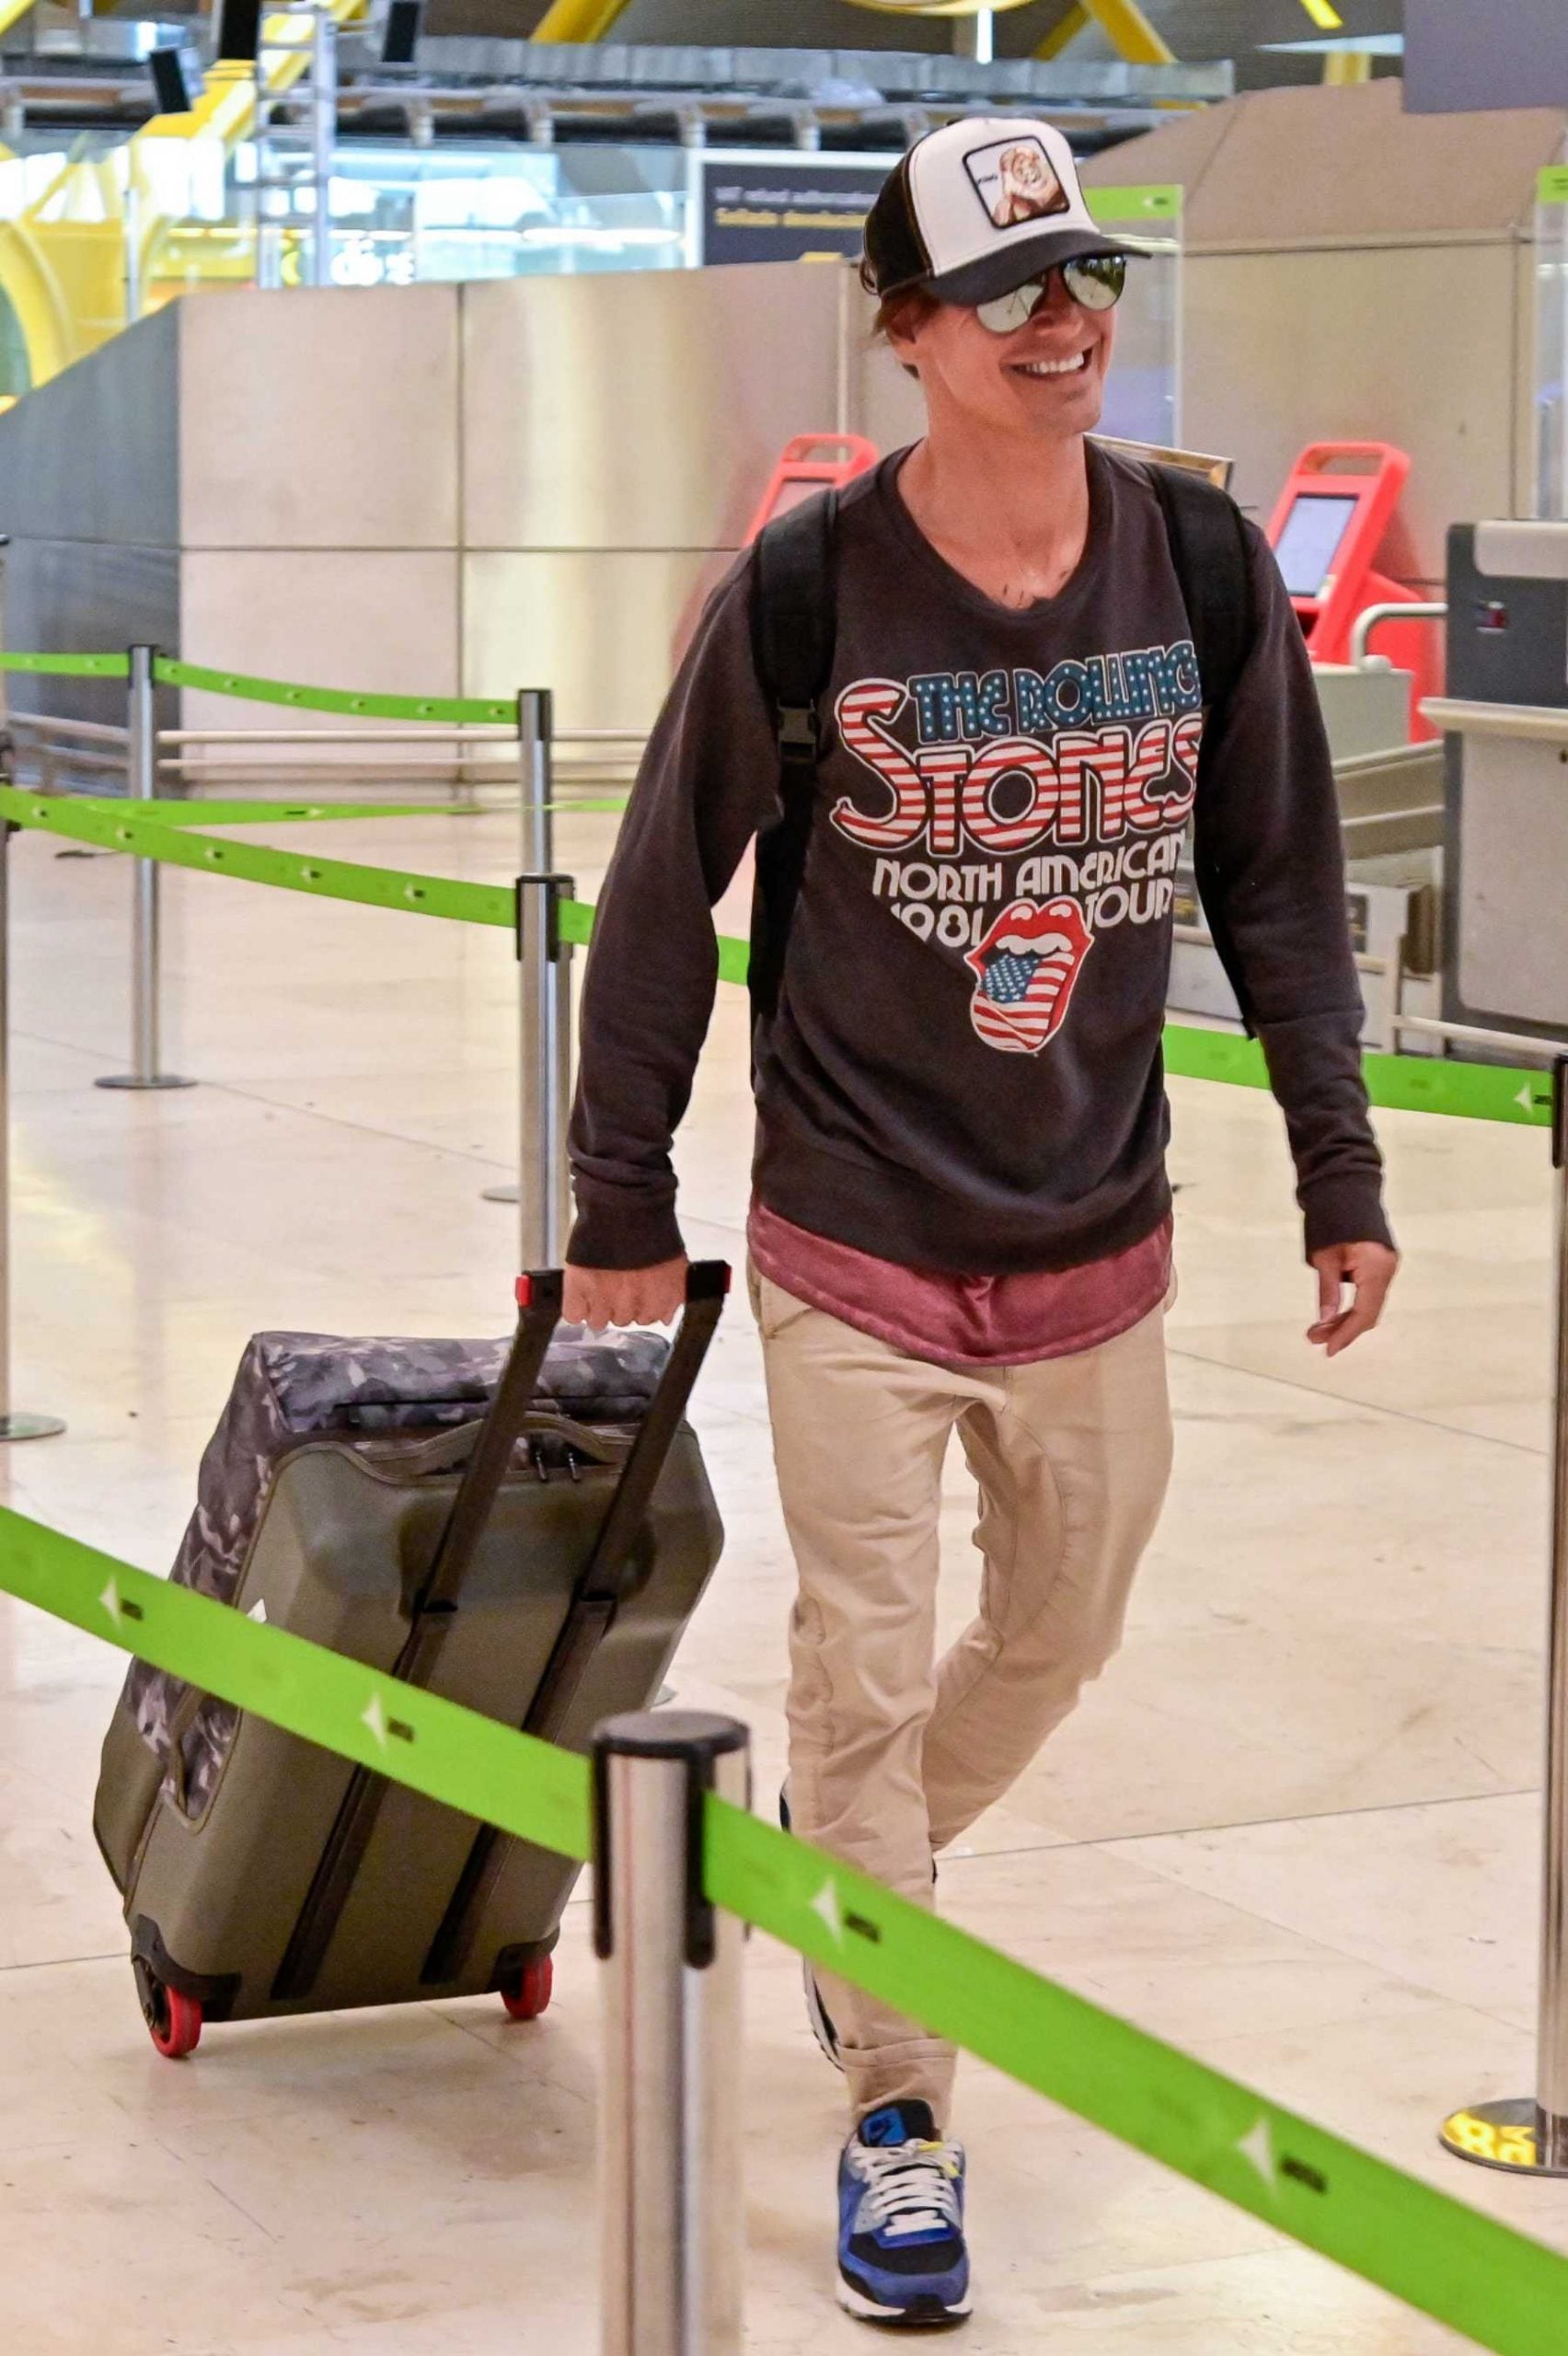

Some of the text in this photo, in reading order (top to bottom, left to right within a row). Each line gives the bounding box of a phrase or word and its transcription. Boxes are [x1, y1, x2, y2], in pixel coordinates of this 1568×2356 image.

[907, 640, 1203, 743] THE ROLLING
[829, 678, 1203, 858] STONES
[871, 828, 1186, 903] NORTH AMERICAN
[890, 877, 1174, 949] 981 TOUR
